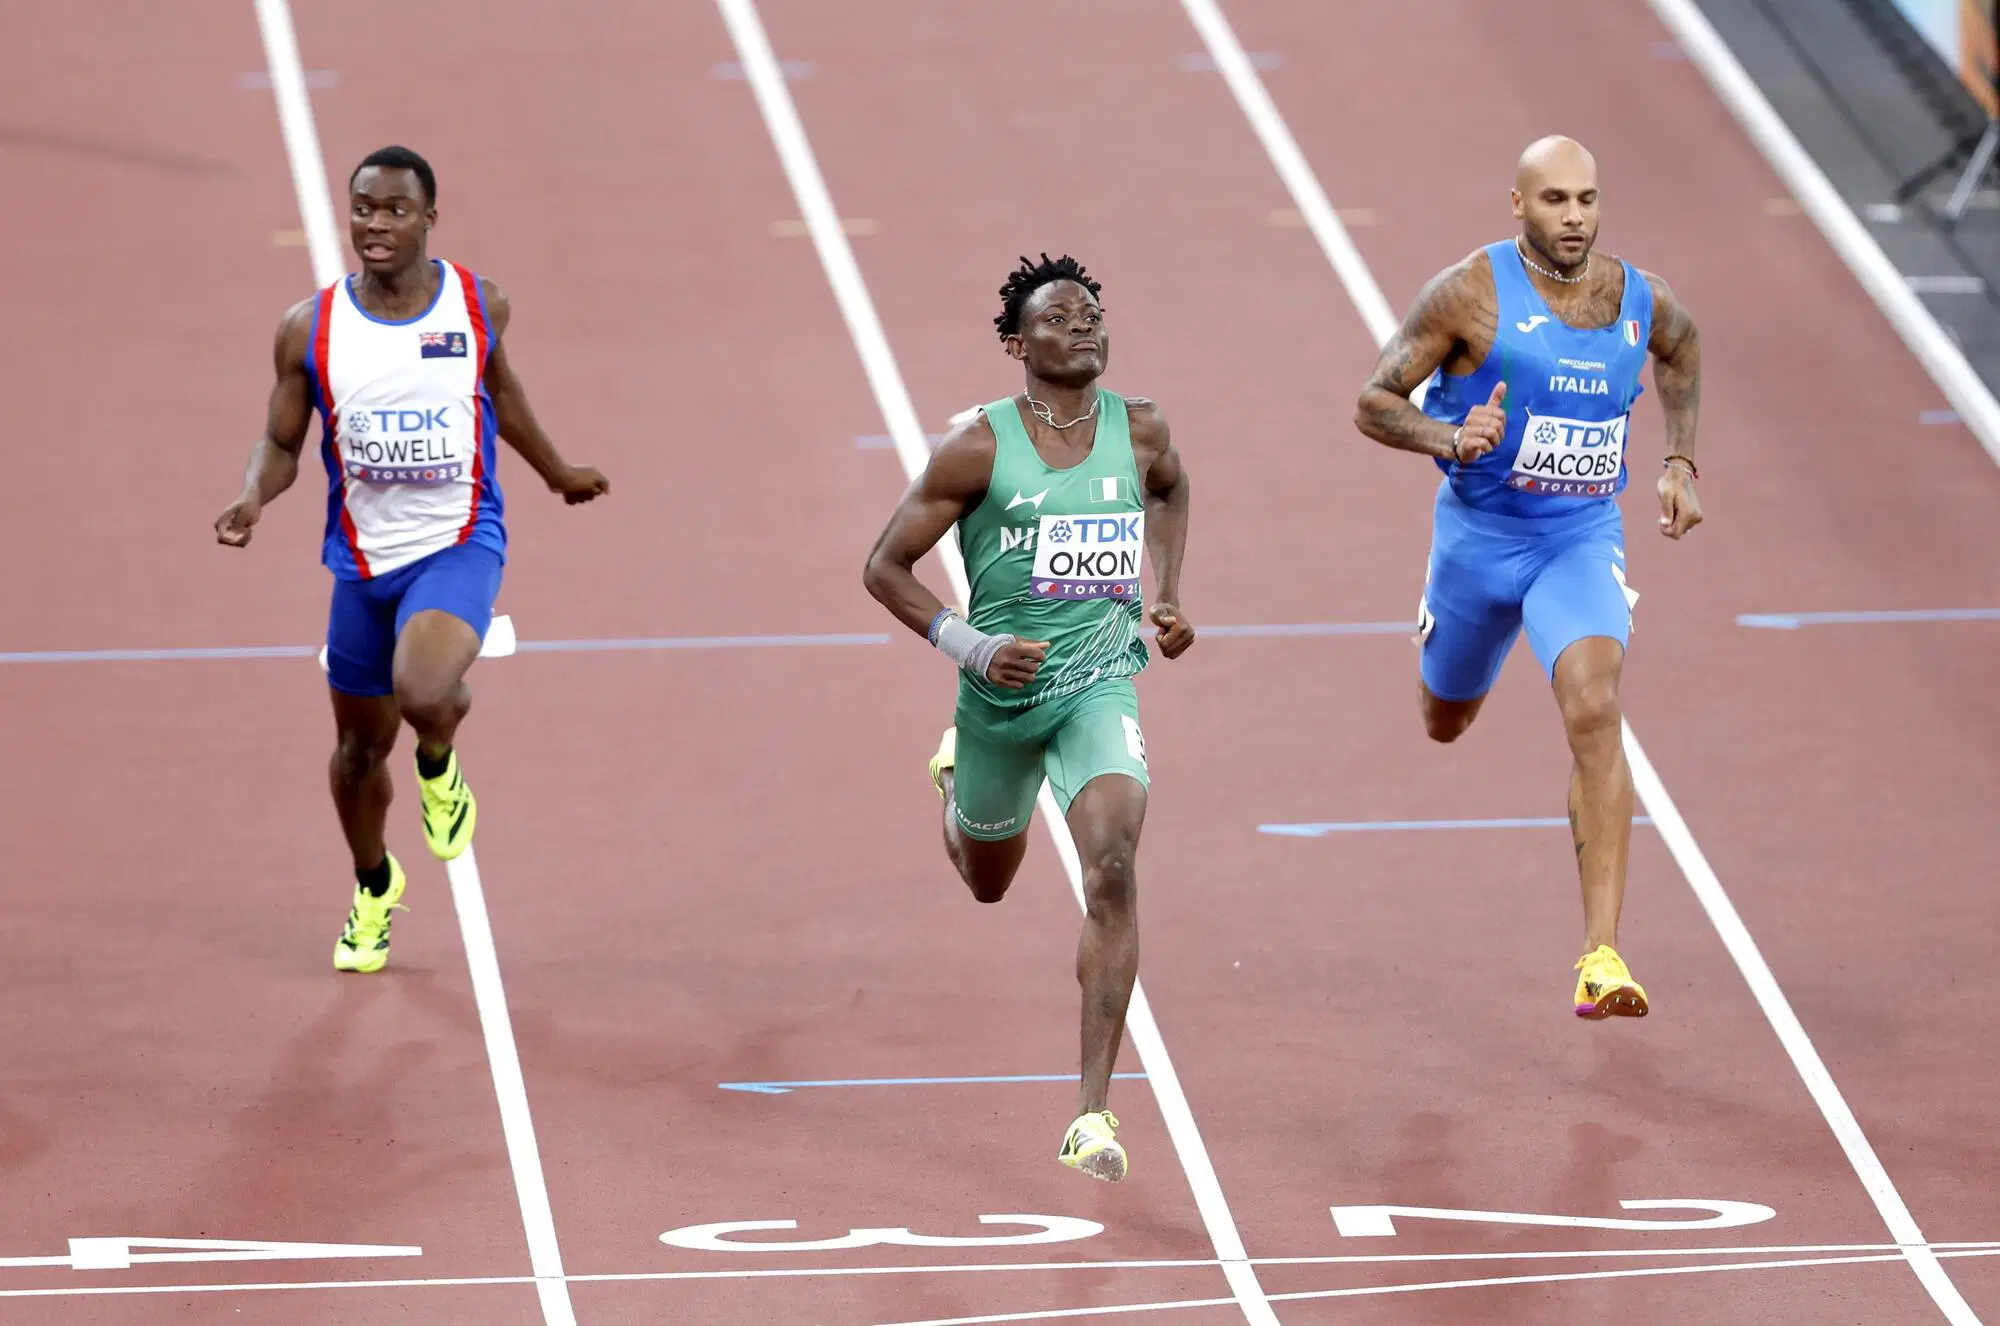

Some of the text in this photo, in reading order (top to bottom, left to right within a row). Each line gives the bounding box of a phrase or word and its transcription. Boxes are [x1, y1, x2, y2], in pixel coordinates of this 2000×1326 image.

[1549, 376, 1609, 395] ITALIA
[371, 406, 451, 432] TDK
[1559, 422, 1620, 448] TDK
[348, 437, 456, 463] HOWELL
[1522, 451, 1618, 477] JACOBS
[1073, 517, 1140, 543] TDK
[1049, 550, 1136, 576] OKON
[1330, 1199, 1776, 1238] 2
[659, 1213, 1104, 1251] 3
[0, 1236, 422, 1270] 4
